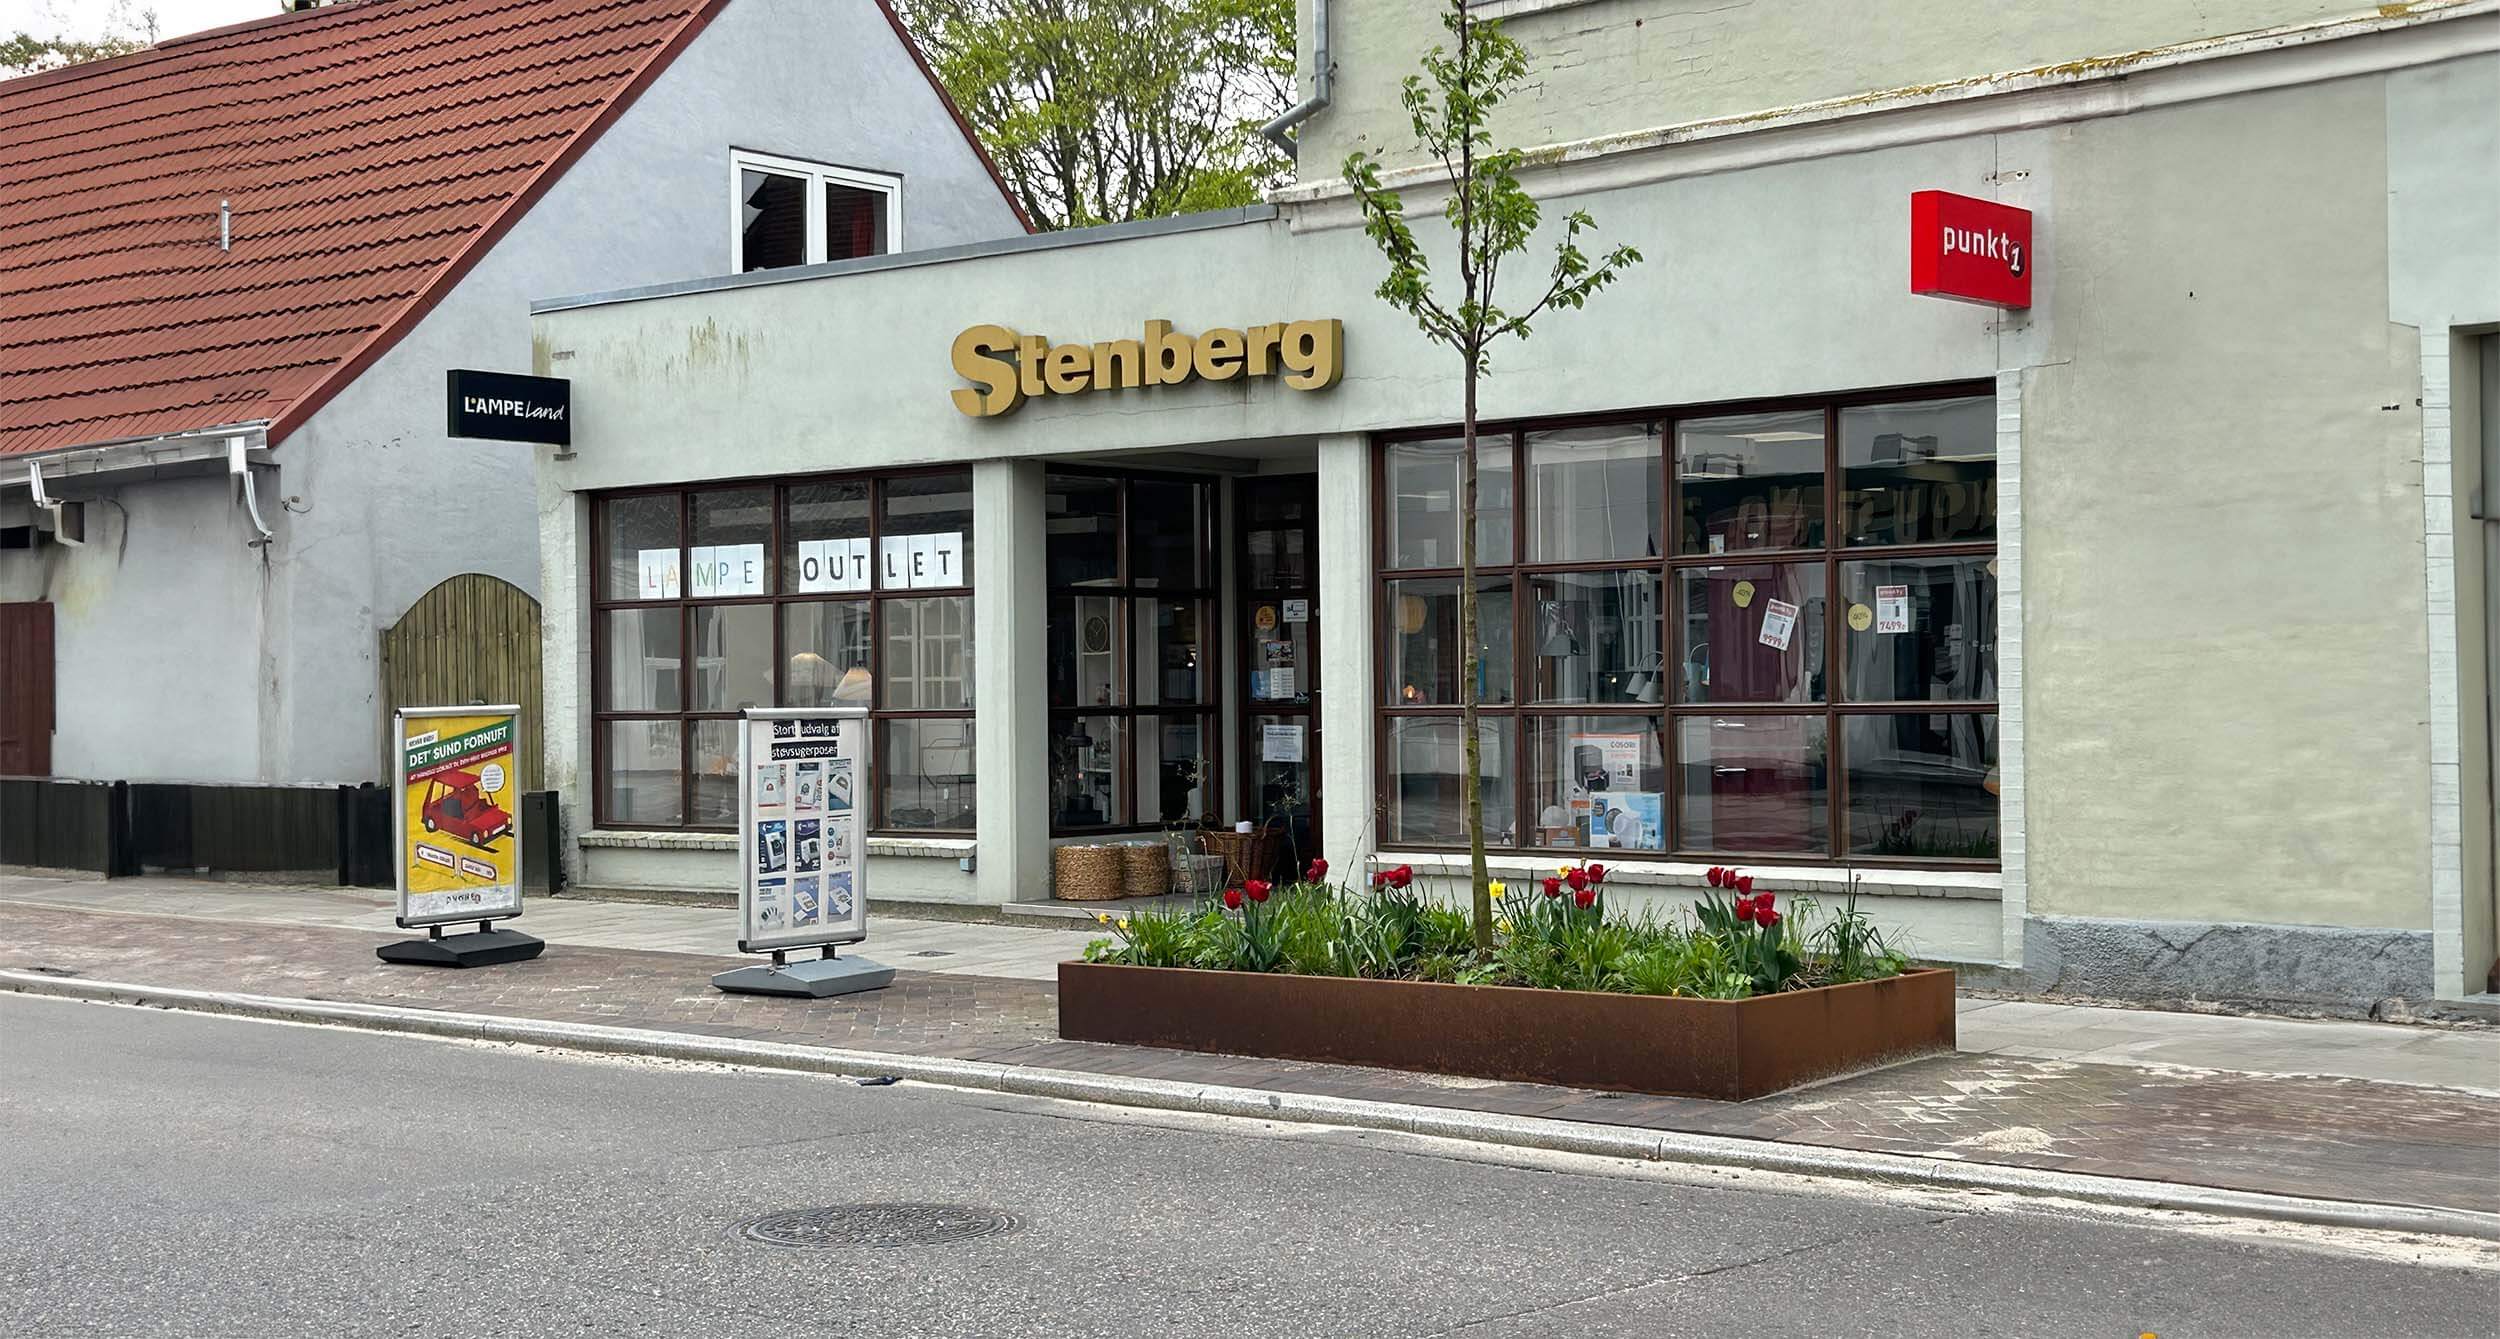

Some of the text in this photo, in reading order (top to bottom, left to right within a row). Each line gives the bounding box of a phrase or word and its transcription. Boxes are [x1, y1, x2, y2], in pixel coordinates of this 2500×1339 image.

[951, 319, 1344, 417] Stenberg
[647, 550, 951, 589] LAMPE OUTLET
[433, 741, 462, 760] SUND
[464, 726, 508, 750] FORNUFT
[773, 724, 796, 735] Stort
[801, 722, 830, 736] udvalg
[771, 745, 838, 759] støvsugerposer
